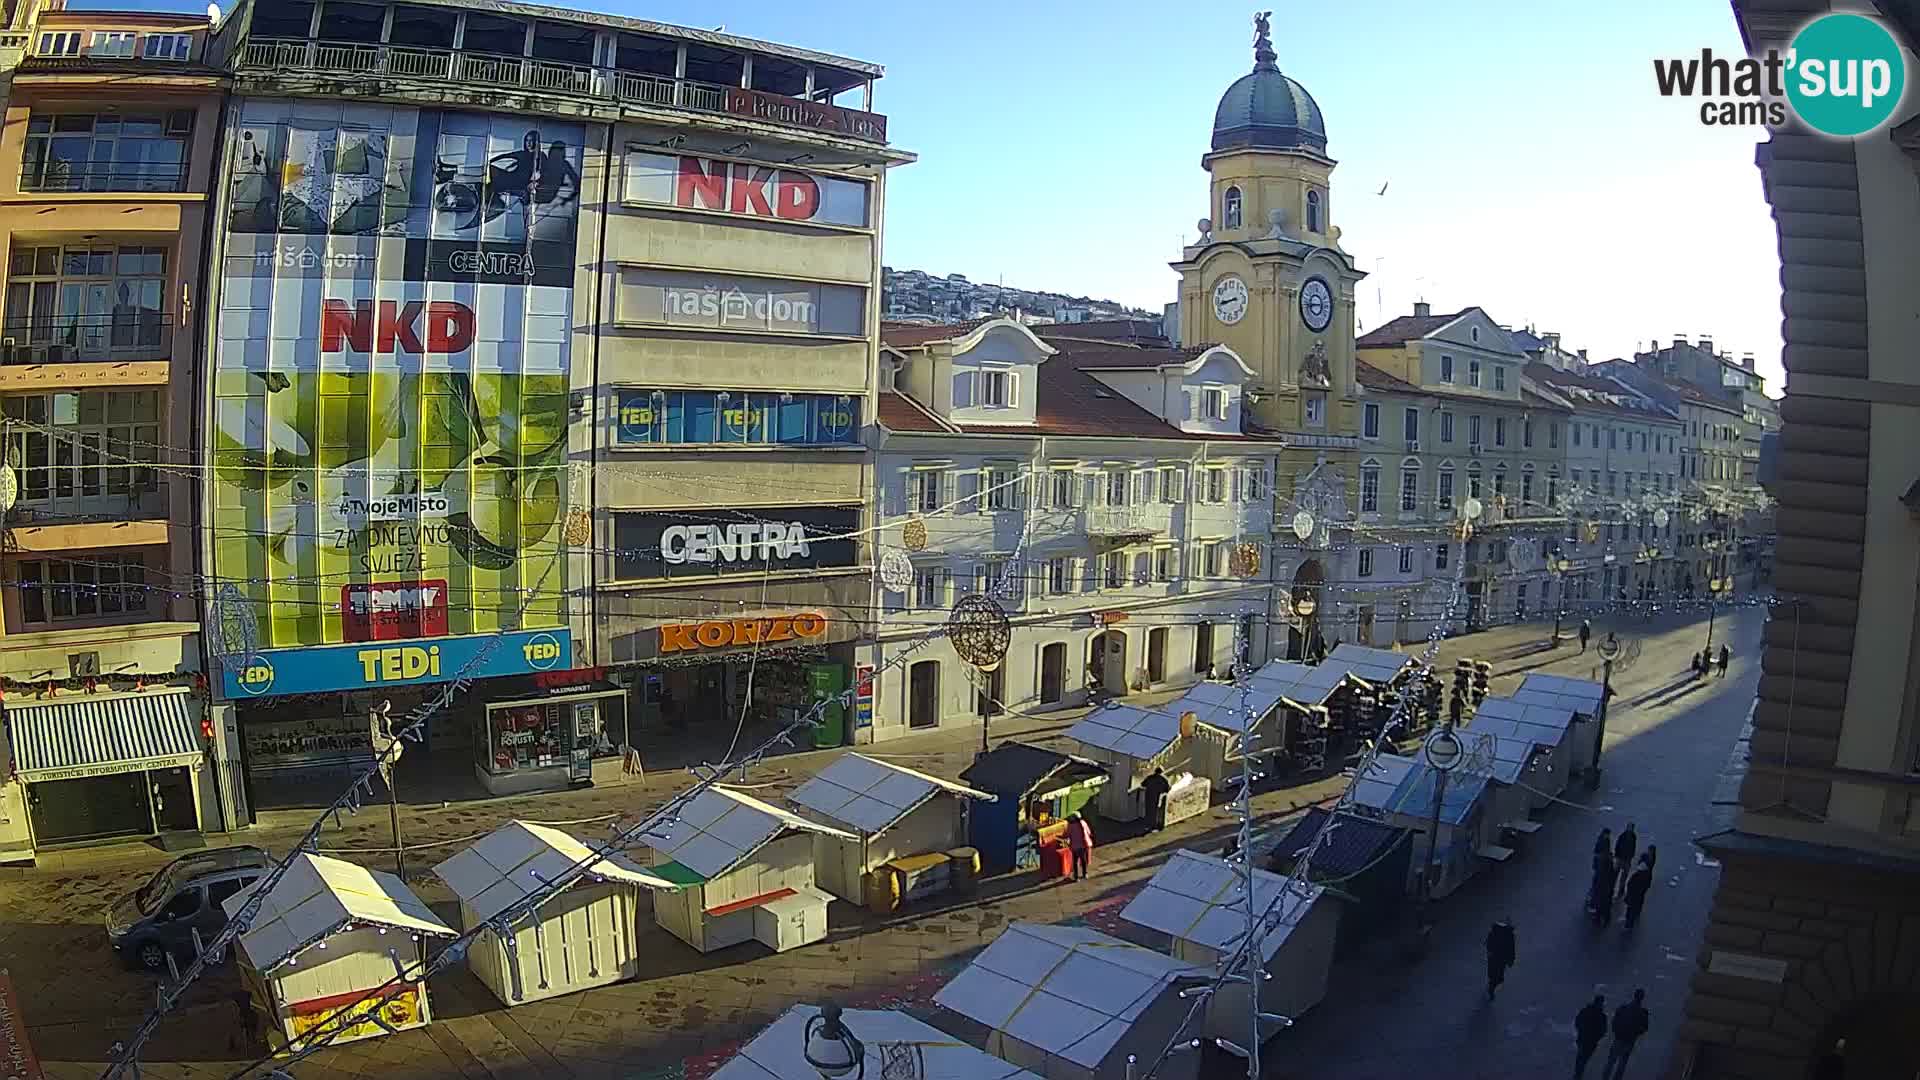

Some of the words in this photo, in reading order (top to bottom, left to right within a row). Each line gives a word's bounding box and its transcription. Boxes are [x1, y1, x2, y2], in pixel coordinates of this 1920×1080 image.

[677, 155, 820, 220] NKD
[449, 250, 535, 275] CENTRA
[666, 283, 719, 317] naš
[754, 291, 817, 324] dom
[320, 299, 477, 353] NKD
[723, 408, 760, 427] TEDi
[335, 529, 358, 549] ZA
[368, 524, 451, 548] DNEVNO
[660, 521, 810, 564] CENTRA
[360, 548, 427, 575] SVJEŽE
[659, 613, 827, 653] KORZO
[358, 645, 440, 682] TEDi
[523, 642, 560, 661] TEDi
[146, 758, 178, 769] CENTAR
